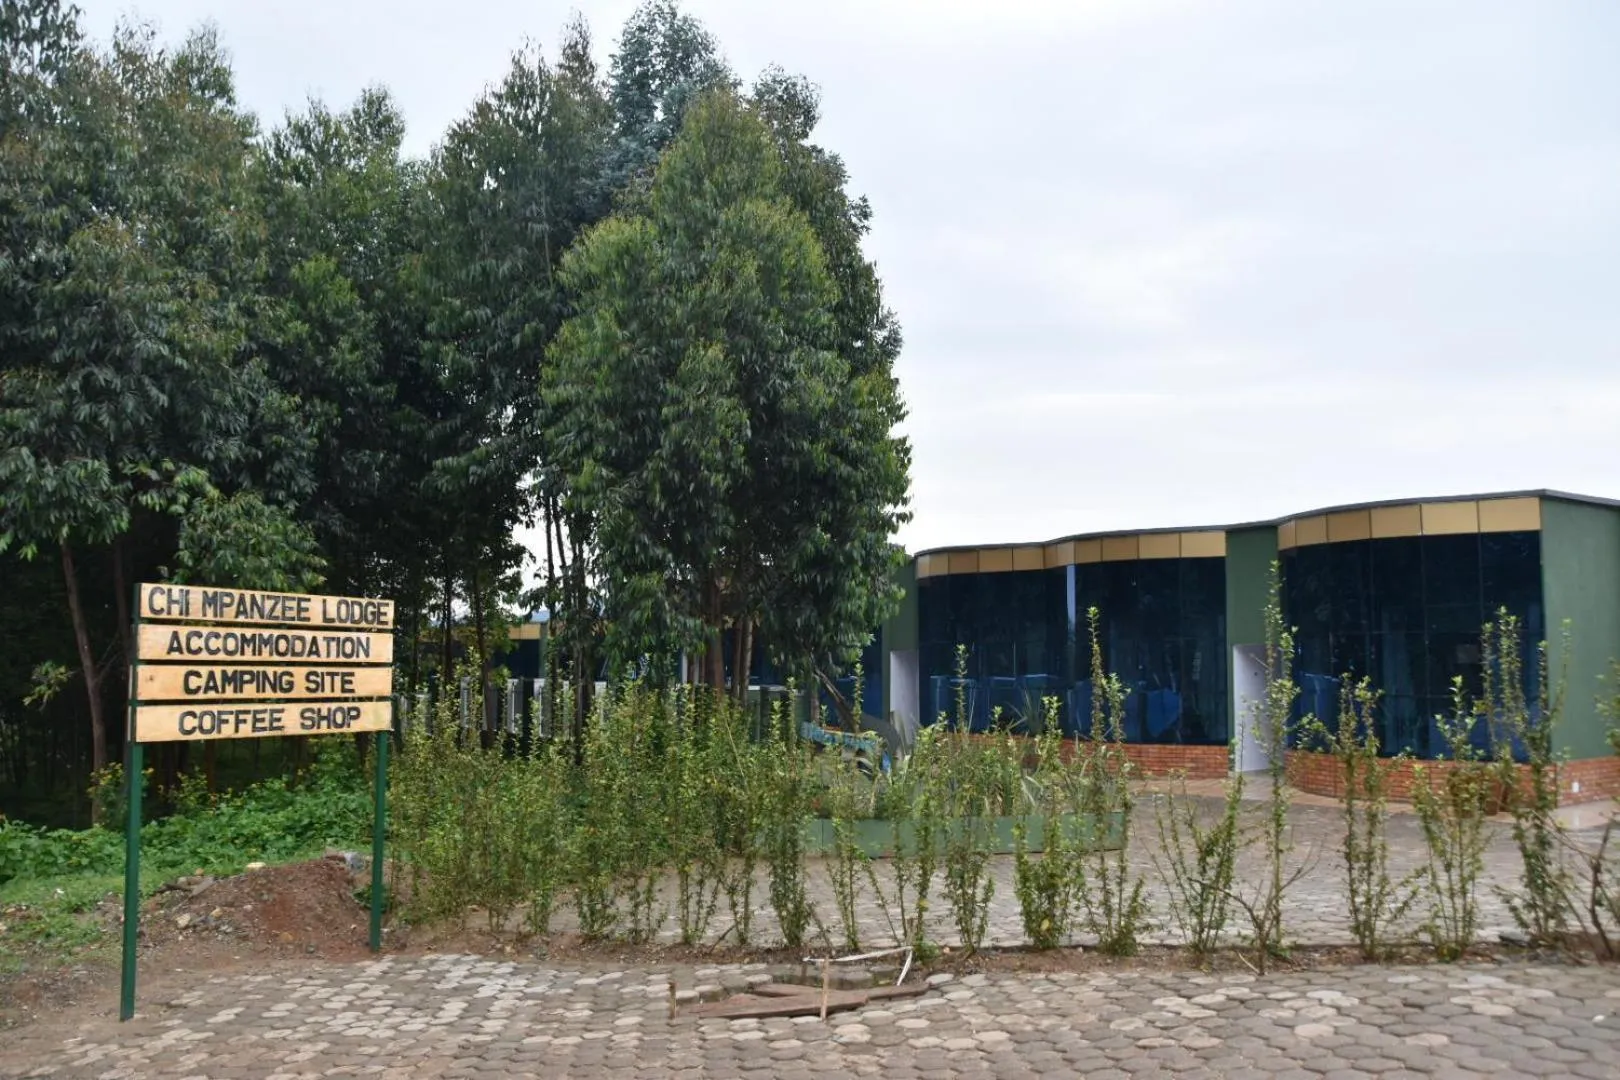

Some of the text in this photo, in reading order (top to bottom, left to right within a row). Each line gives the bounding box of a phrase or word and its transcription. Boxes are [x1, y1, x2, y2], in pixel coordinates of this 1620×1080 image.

[322, 598, 390, 626] LODGE
[167, 630, 371, 659] ACCOMMODATION
[183, 669, 356, 695] CAMPING SITE
[178, 706, 361, 736] COFFEE SHOP
